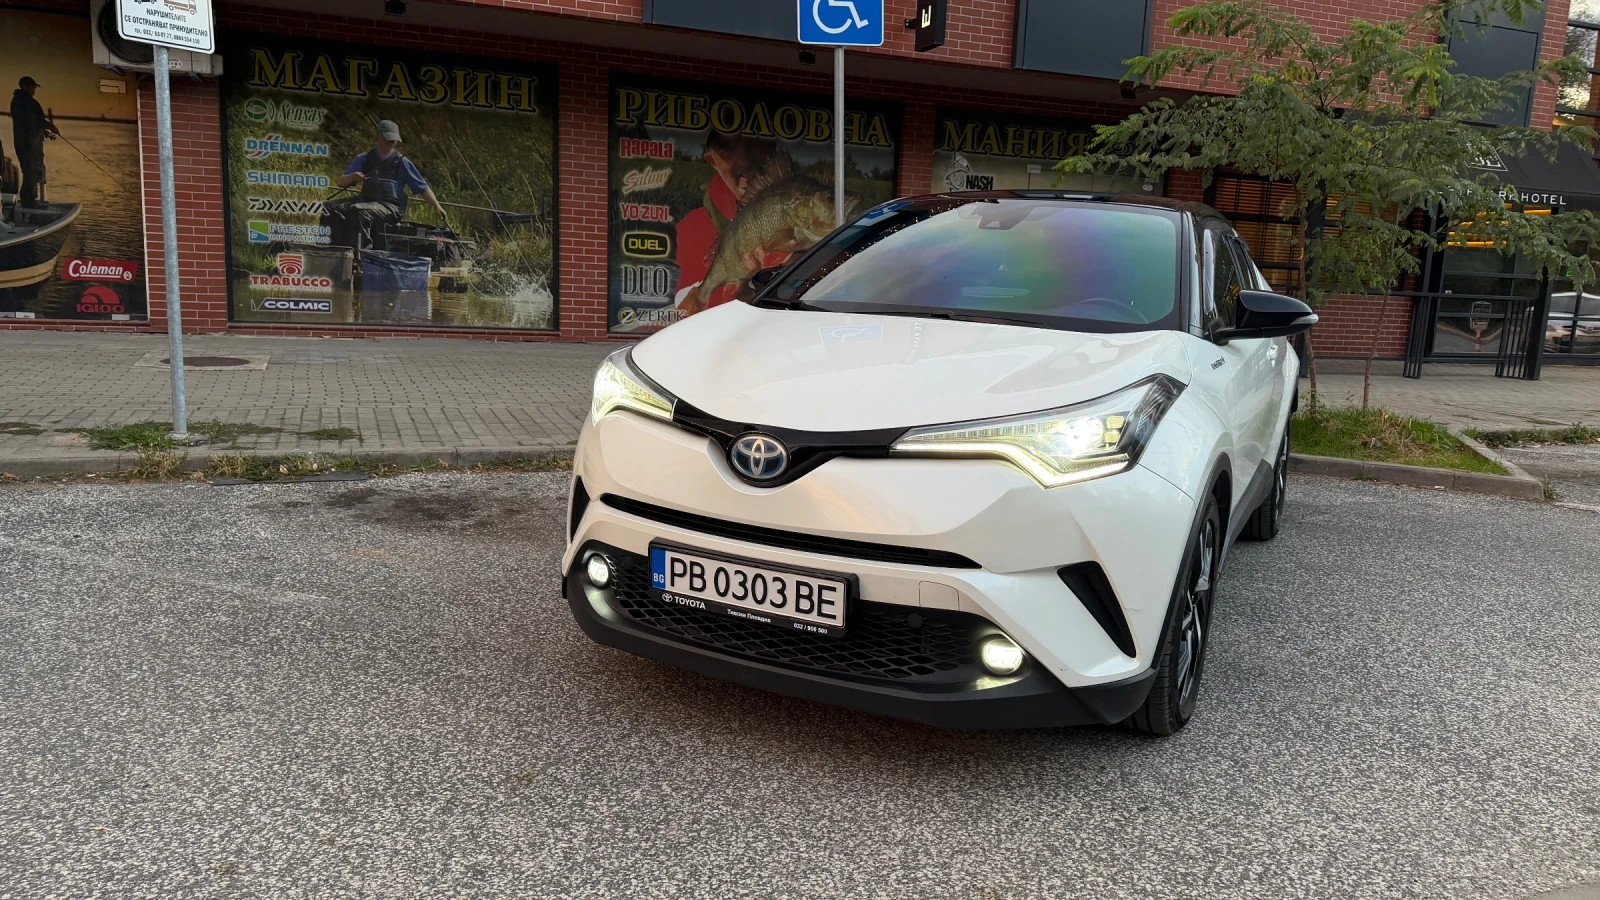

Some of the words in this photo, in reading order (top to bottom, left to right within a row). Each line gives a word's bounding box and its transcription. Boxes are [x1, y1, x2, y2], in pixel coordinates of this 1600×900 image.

[146, 8, 187, 22] НАРУШИТЕЛИТЕ
[124, 15, 132, 23] СЕ
[132, 16, 168, 28] ОТСТРАНЯВАТ
[169, 23, 208, 37] ПРИНУДИТЕЛНО
[248, 49, 537, 112] МАГАЗИН
[279, 101, 325, 122] Sensas
[615, 88, 893, 147] РИБОЛОВНА
[246, 139, 328, 155] DRENNAN
[942, 121, 1091, 160] МАНИЯ
[247, 171, 329, 188] SHIMANO
[966, 174, 994, 191] NASH
[249, 198, 330, 215] DAIWA
[1520, 192, 1567, 206] HOTEL
[621, 203, 669, 221] YO-ZURI
[270, 224, 331, 235] PRESTON
[270, 234, 331, 243] INNOVATIONS
[628, 238, 663, 251] DUEL
[68, 260, 123, 278] Coleman
[251, 275, 331, 288] TRABUCCO
[622, 265, 669, 296] DUO
[76, 303, 125, 314] IGLOO
[264, 300, 330, 311] COLMIC
[637, 309, 686, 322] ZEREK
[653, 572, 665, 584] BG
[670, 556, 707, 593] PB
[713, 566, 788, 609] 0303
[795, 579, 837, 620] BE
[674, 595, 706, 609] TOYOTA
